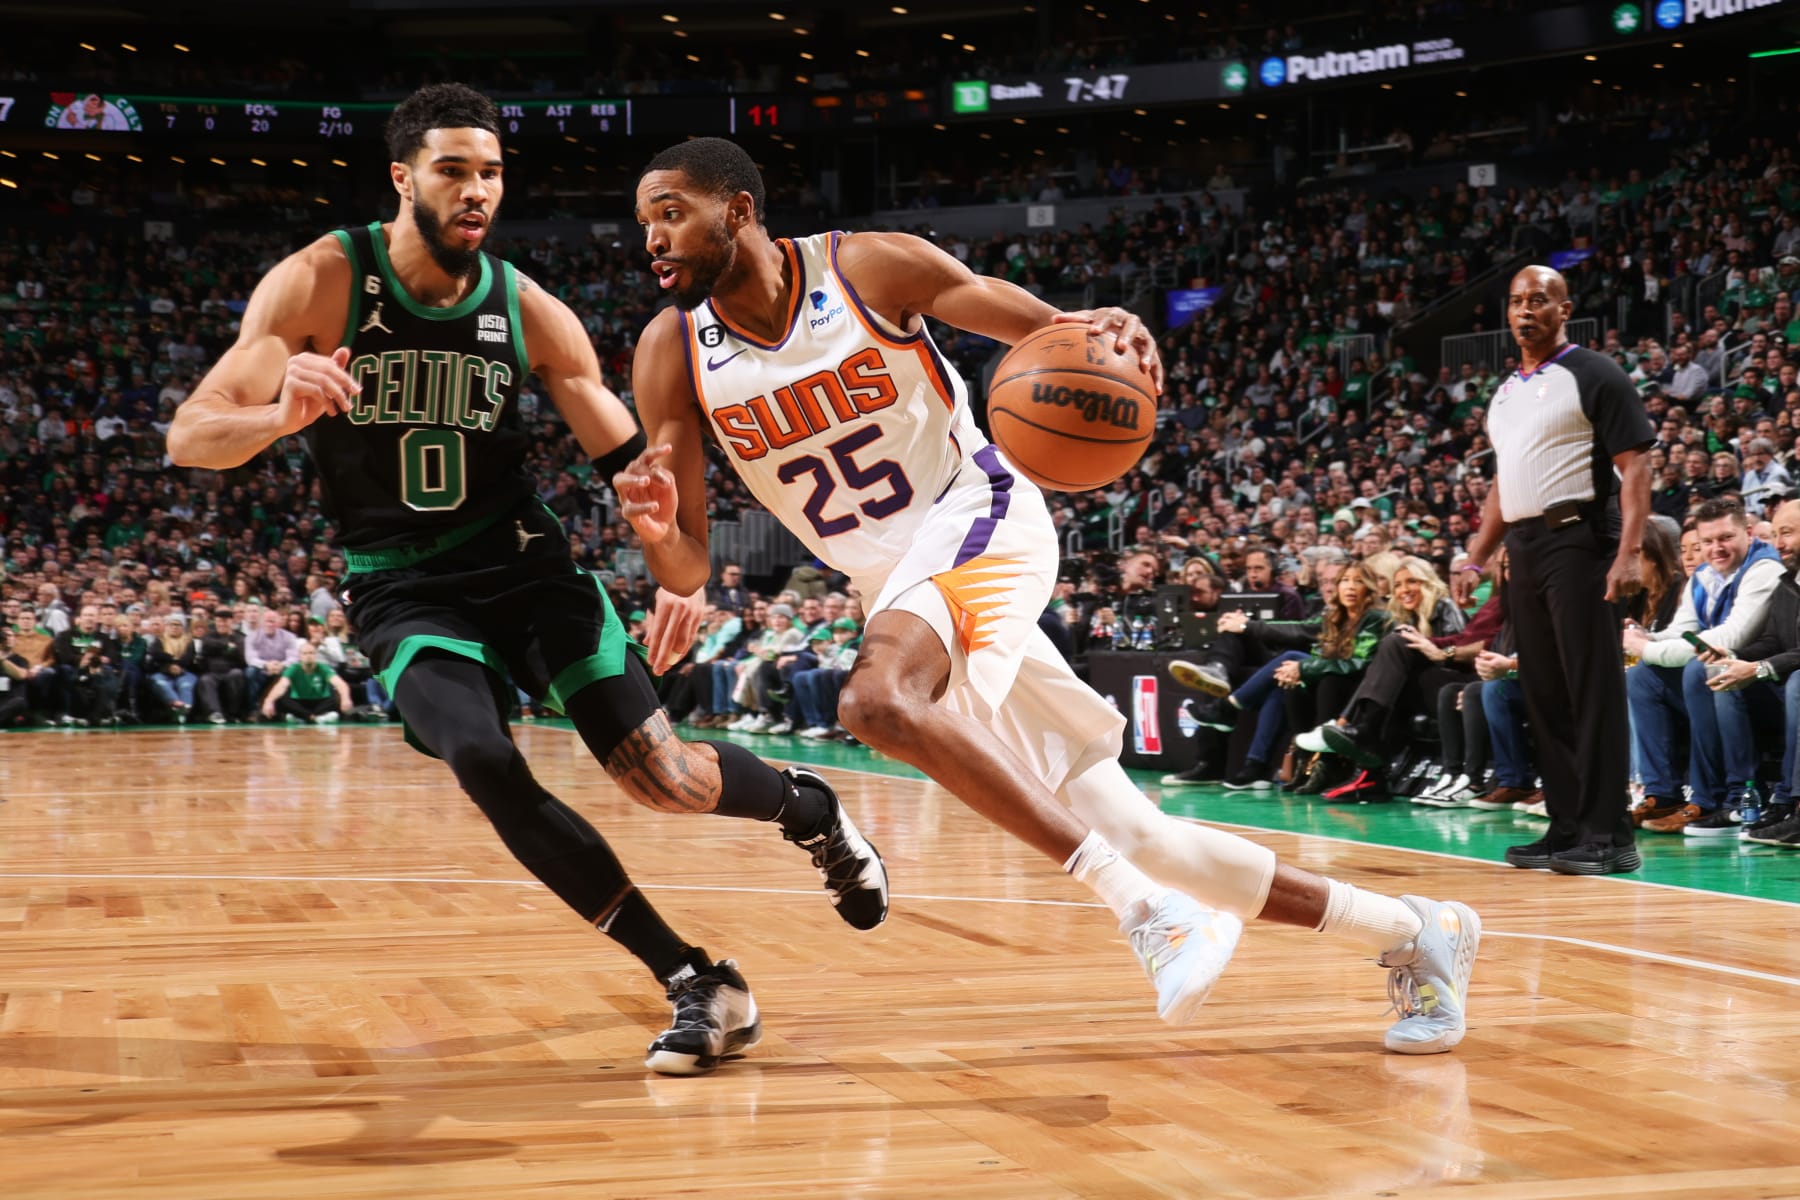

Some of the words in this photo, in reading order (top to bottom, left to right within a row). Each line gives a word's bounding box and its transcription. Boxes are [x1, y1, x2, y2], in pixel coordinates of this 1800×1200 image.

[1685, 0, 1783, 23] Put
[1287, 44, 1409, 83] Putnam
[991, 81, 1043, 99] Bank
[1065, 74, 1129, 102] 7:47
[245, 104, 278, 116] FG%
[323, 107, 341, 119] FG
[502, 105, 524, 117] STL
[546, 104, 572, 116] AST
[591, 104, 616, 116] REB
[748, 105, 778, 126] 11
[252, 120, 270, 132] 20
[320, 122, 353, 136] 2/10
[365, 275, 382, 295] 6
[477, 314, 507, 331] VISTA
[810, 304, 844, 330] PayPal
[477, 330, 507, 343] PRINT
[704, 329, 721, 345] 6
[347, 349, 512, 432] CELTICS
[711, 347, 899, 461] SUNS
[1032, 382, 1139, 431] Wilson
[400, 428, 467, 512] 0
[777, 423, 914, 538] 25
